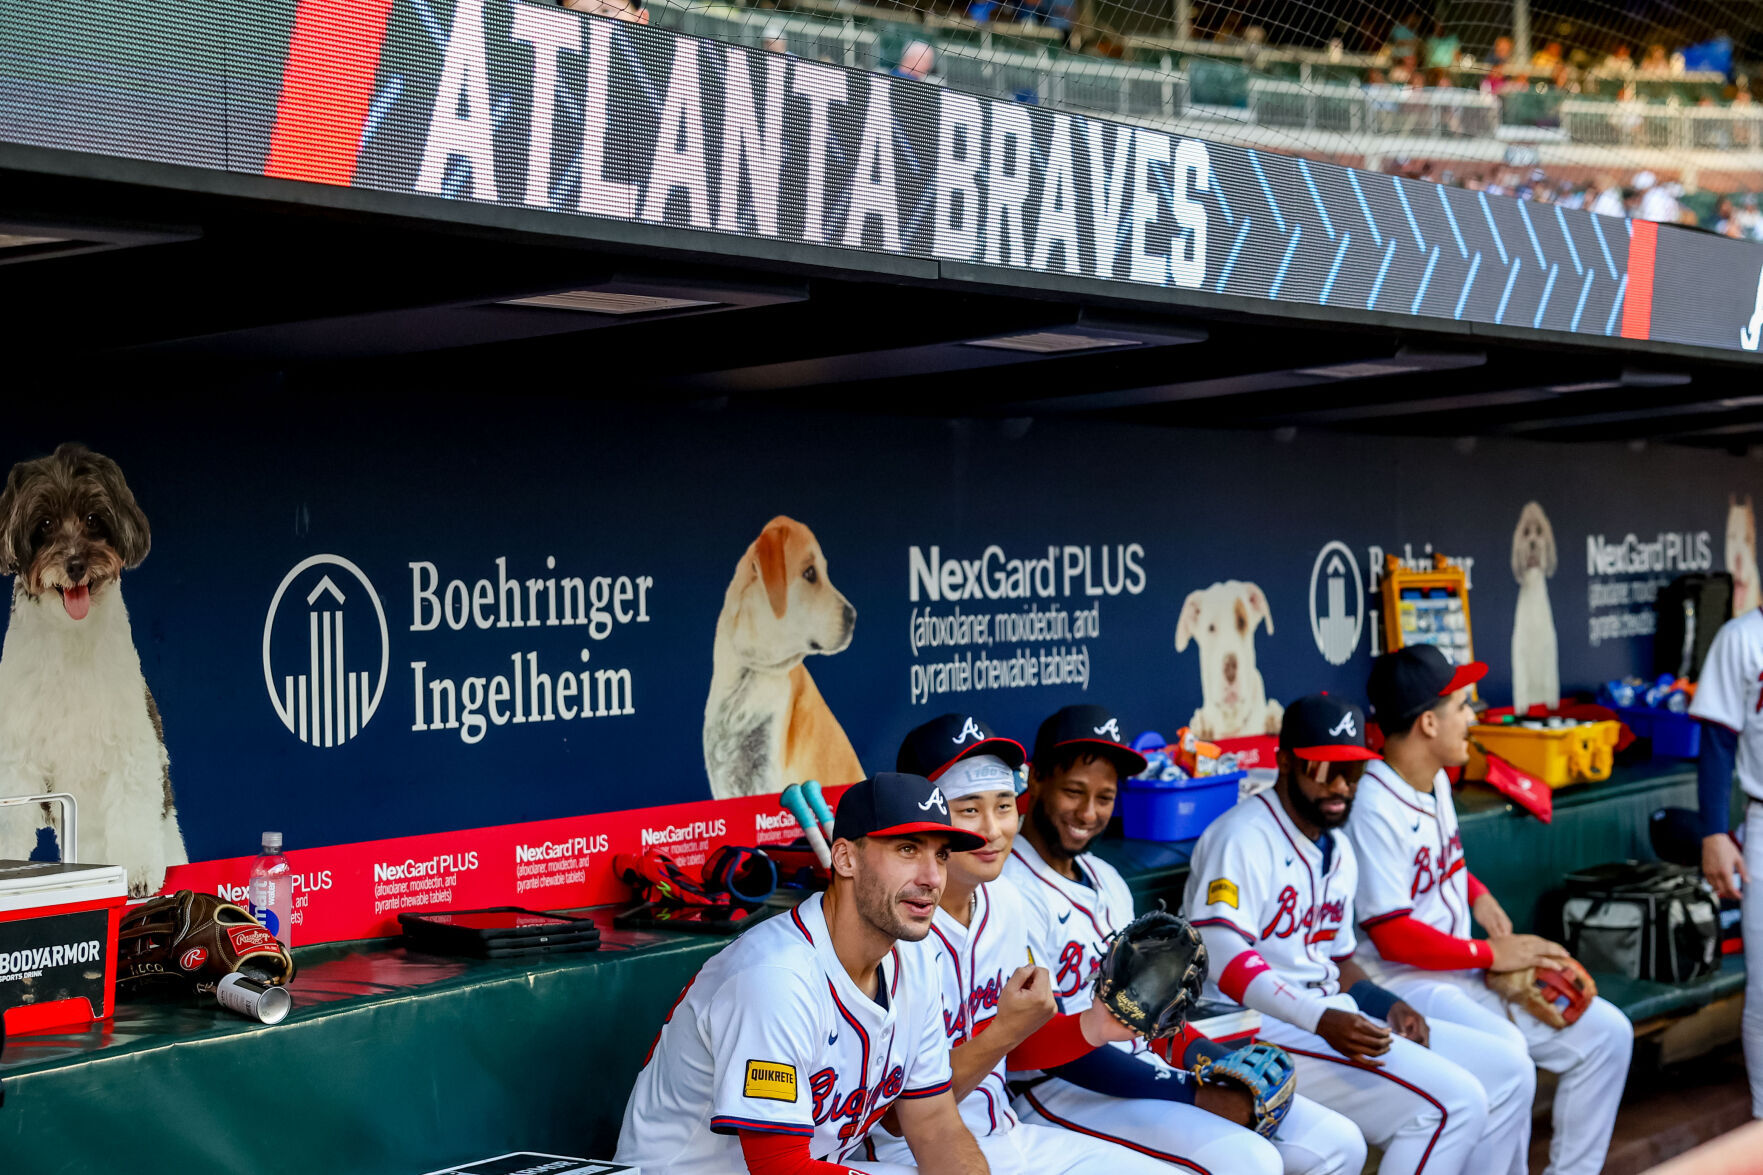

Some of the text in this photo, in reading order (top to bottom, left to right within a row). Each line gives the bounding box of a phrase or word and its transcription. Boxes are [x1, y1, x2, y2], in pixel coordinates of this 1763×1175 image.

[415, 0, 1211, 289] ATLANTA BRAVES
[1664, 531, 1712, 571] PLUS
[1063, 543, 1146, 596] PLUS
[408, 555, 653, 640] Boehringer
[910, 606, 993, 657] (afoxolaner,
[1073, 601, 1099, 639] and
[910, 645, 1090, 704] pyrantel chewable tablets)
[410, 648, 635, 744] Ingelheim
[952, 716, 985, 744] A
[1093, 718, 1121, 742] A
[1328, 711, 1357, 737] A
[918, 787, 948, 815] A
[694, 818, 727, 839] PLUS
[755, 811, 796, 830] NexGa
[574, 834, 609, 855] PLUS
[440, 851, 479, 874] PLUS
[291, 871, 333, 893] PLUS
[445, 873, 457, 887] and
[255, 881, 267, 928] mart
[375, 896, 400, 914] pyrantel
[401, 892, 429, 908] chewable
[0, 940, 101, 975] BODYARMOR
[23, 969, 43, 979] DRINK
[751, 1068, 794, 1084] QUIKRETE
